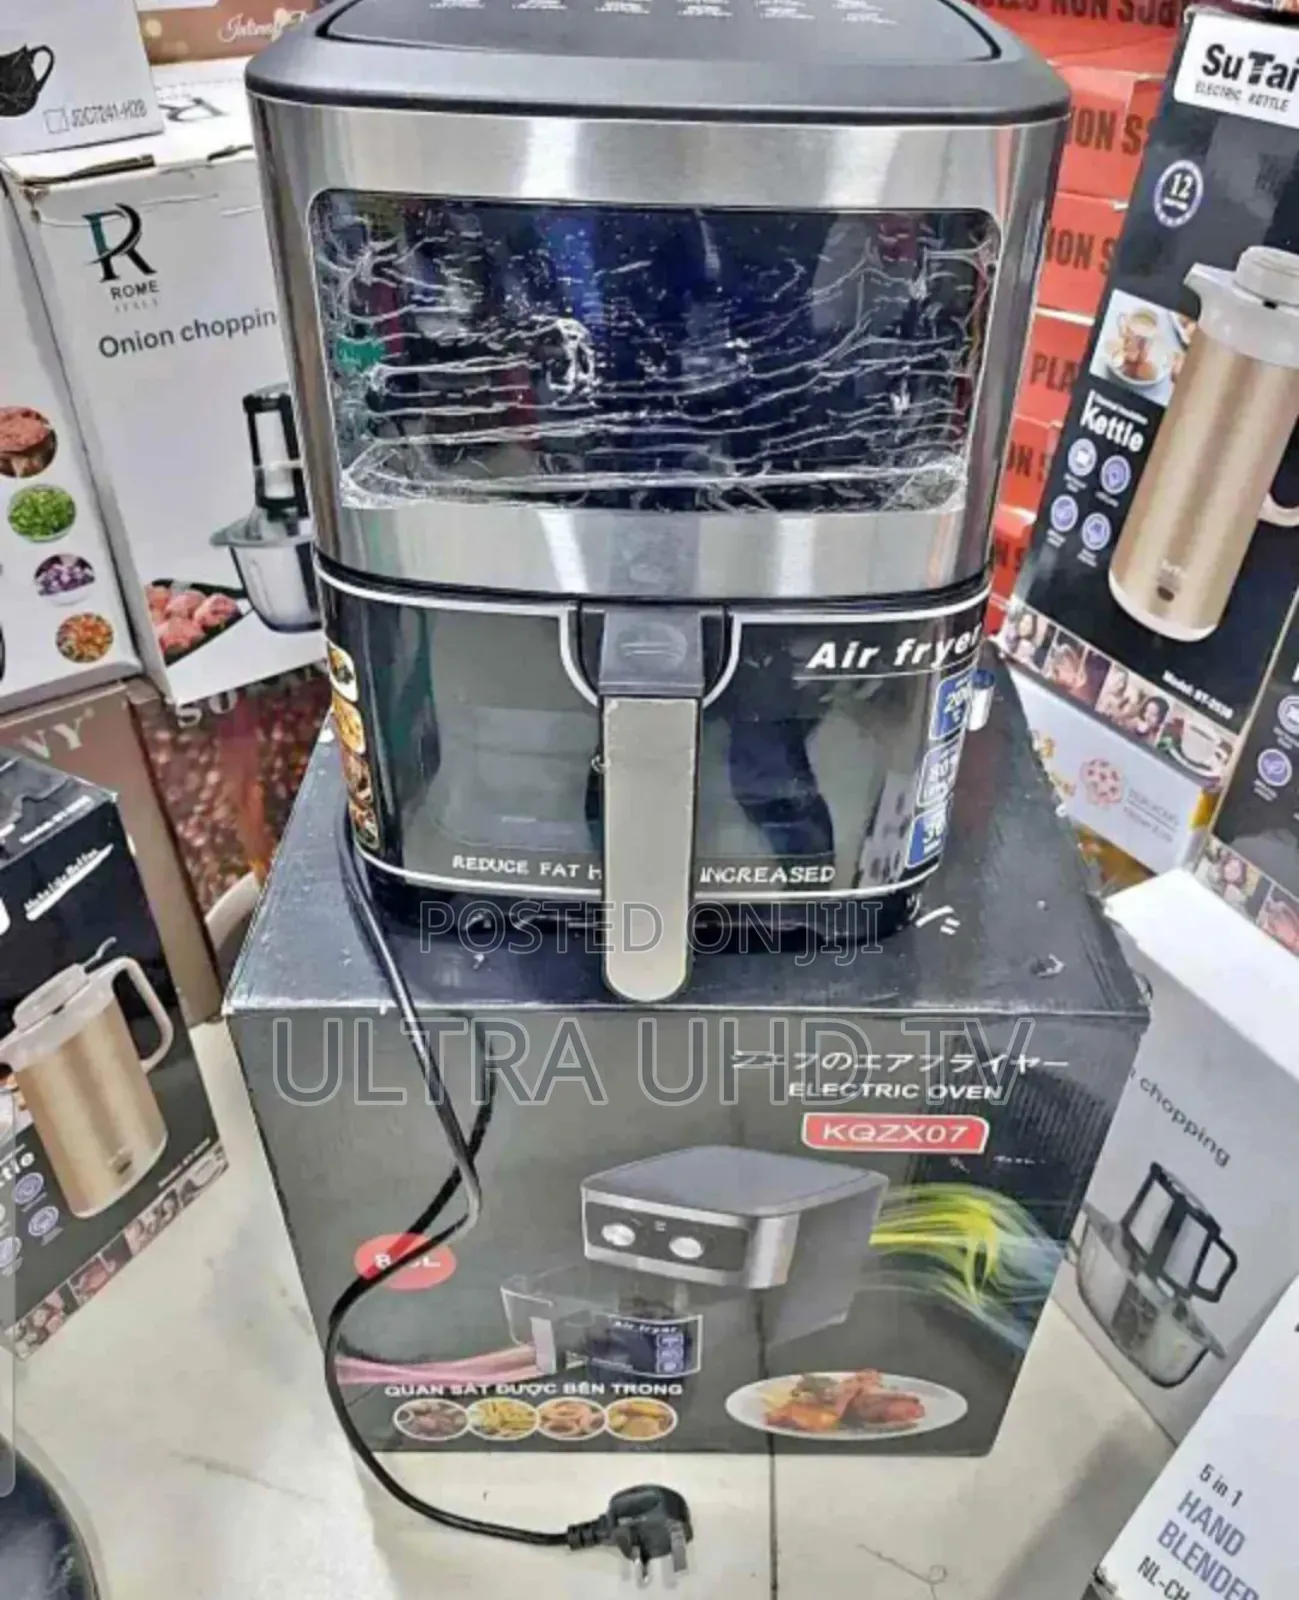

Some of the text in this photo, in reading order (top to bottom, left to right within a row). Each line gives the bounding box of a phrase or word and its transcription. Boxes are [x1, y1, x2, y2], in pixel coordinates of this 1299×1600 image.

[1169, 172, 1194, 199] 12
[109, 280, 160, 300] ROME
[98, 328, 175, 358] Onion
[1079, 389, 1144, 452] Kettle
[805, 621, 984, 670] Air fryer
[452, 855, 529, 875] REDUCE
[540, 861, 579, 879] FAT
[700, 865, 836, 884] INCREASED
[788, 1082, 1003, 1101] ELECTRIC OVEN
[823, 1122, 969, 1143] KQZX07
[1139, 1077, 1231, 1167] chopping
[385, 1383, 444, 1397] QUAN
[611, 1383, 683, 1396] TRONG
[1199, 1463, 1243, 1507] 5 in 1
[1176, 1489, 1246, 1557] HAND
